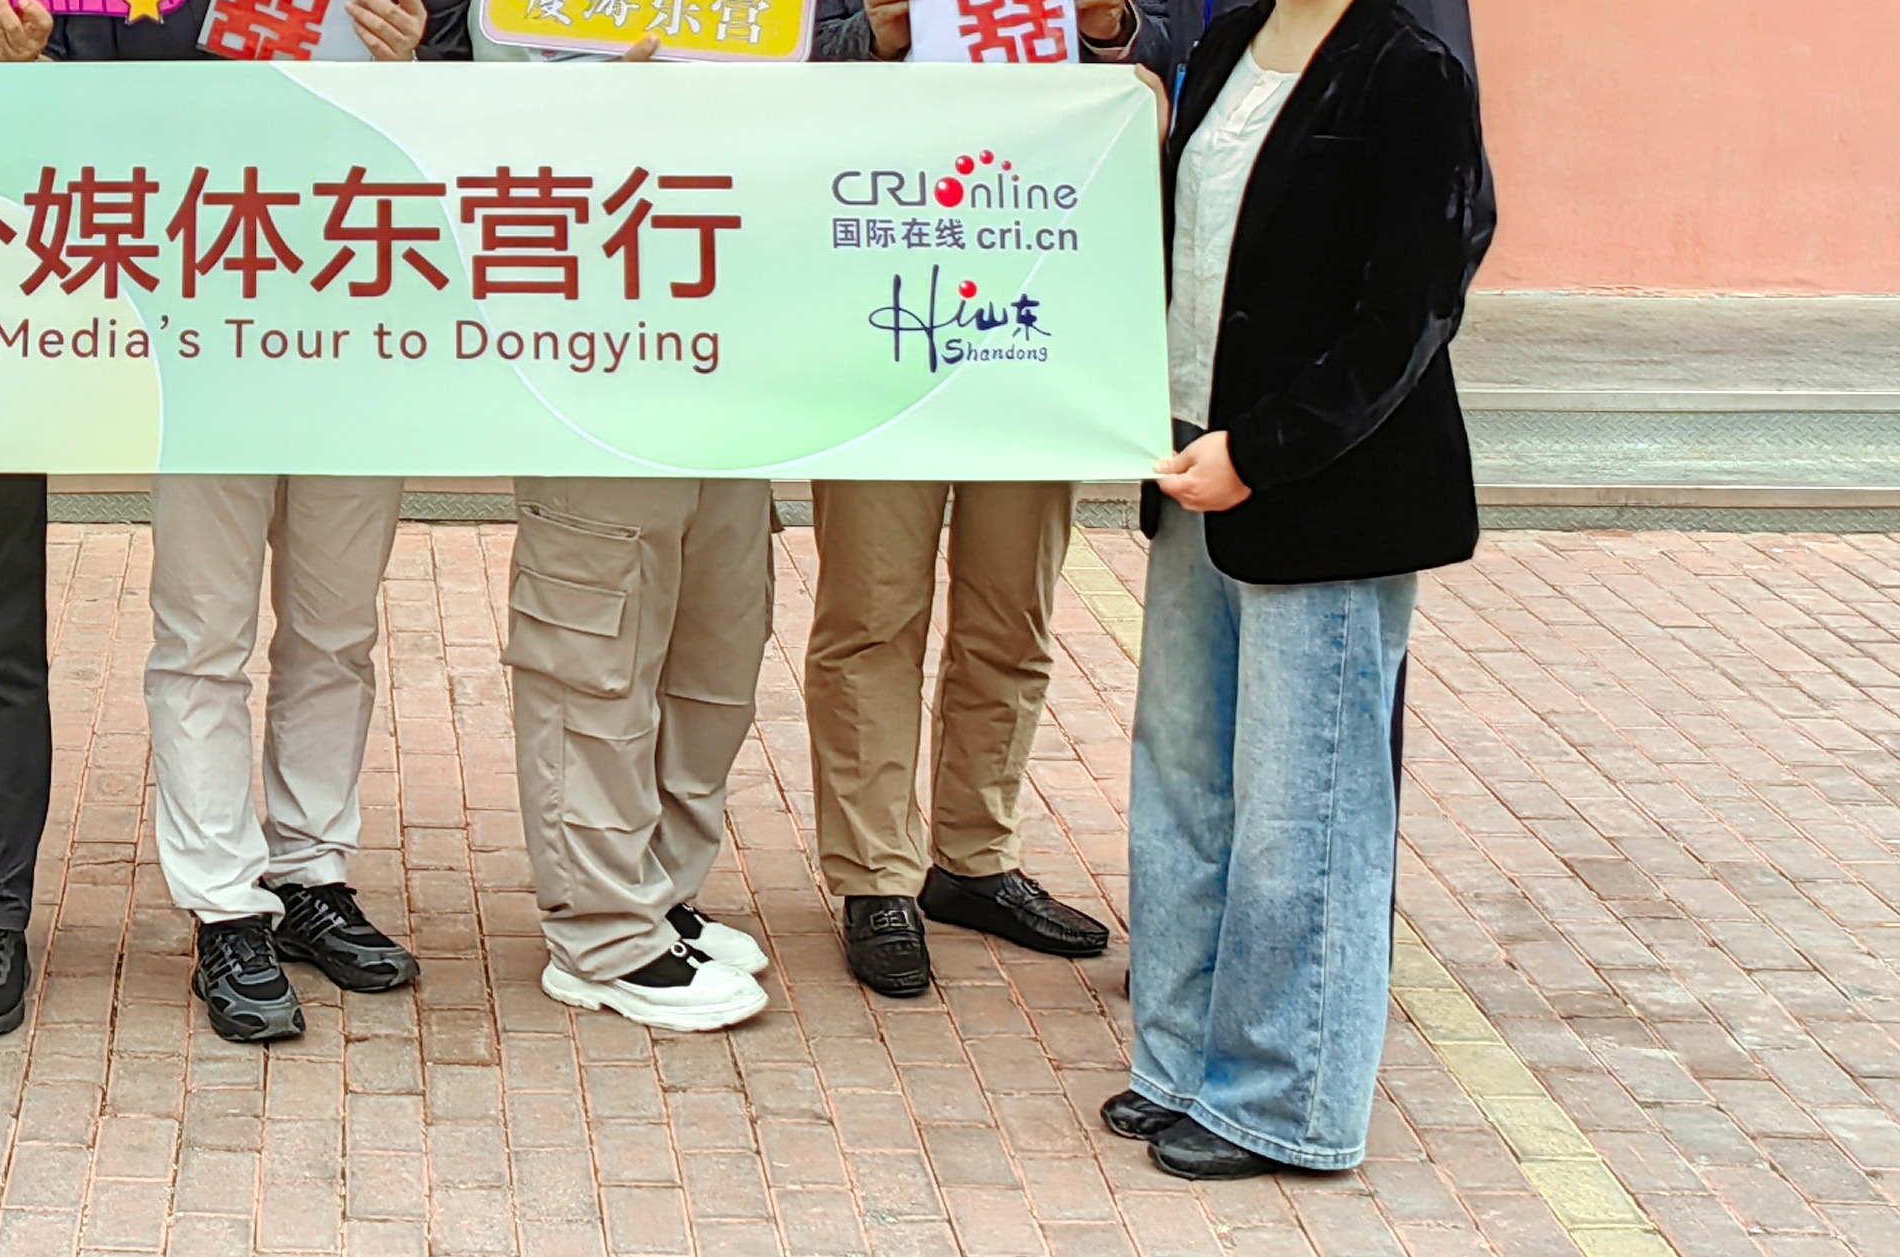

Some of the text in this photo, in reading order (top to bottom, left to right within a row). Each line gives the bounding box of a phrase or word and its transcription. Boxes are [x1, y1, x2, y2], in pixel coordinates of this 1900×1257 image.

[833, 218, 1078, 251] 国际在线 cri.cn
[224, 317, 351, 360] Tour
[374, 322, 428, 360] to
[454, 318, 720, 375] Dongying
[941, 338, 1048, 365] Shandong
